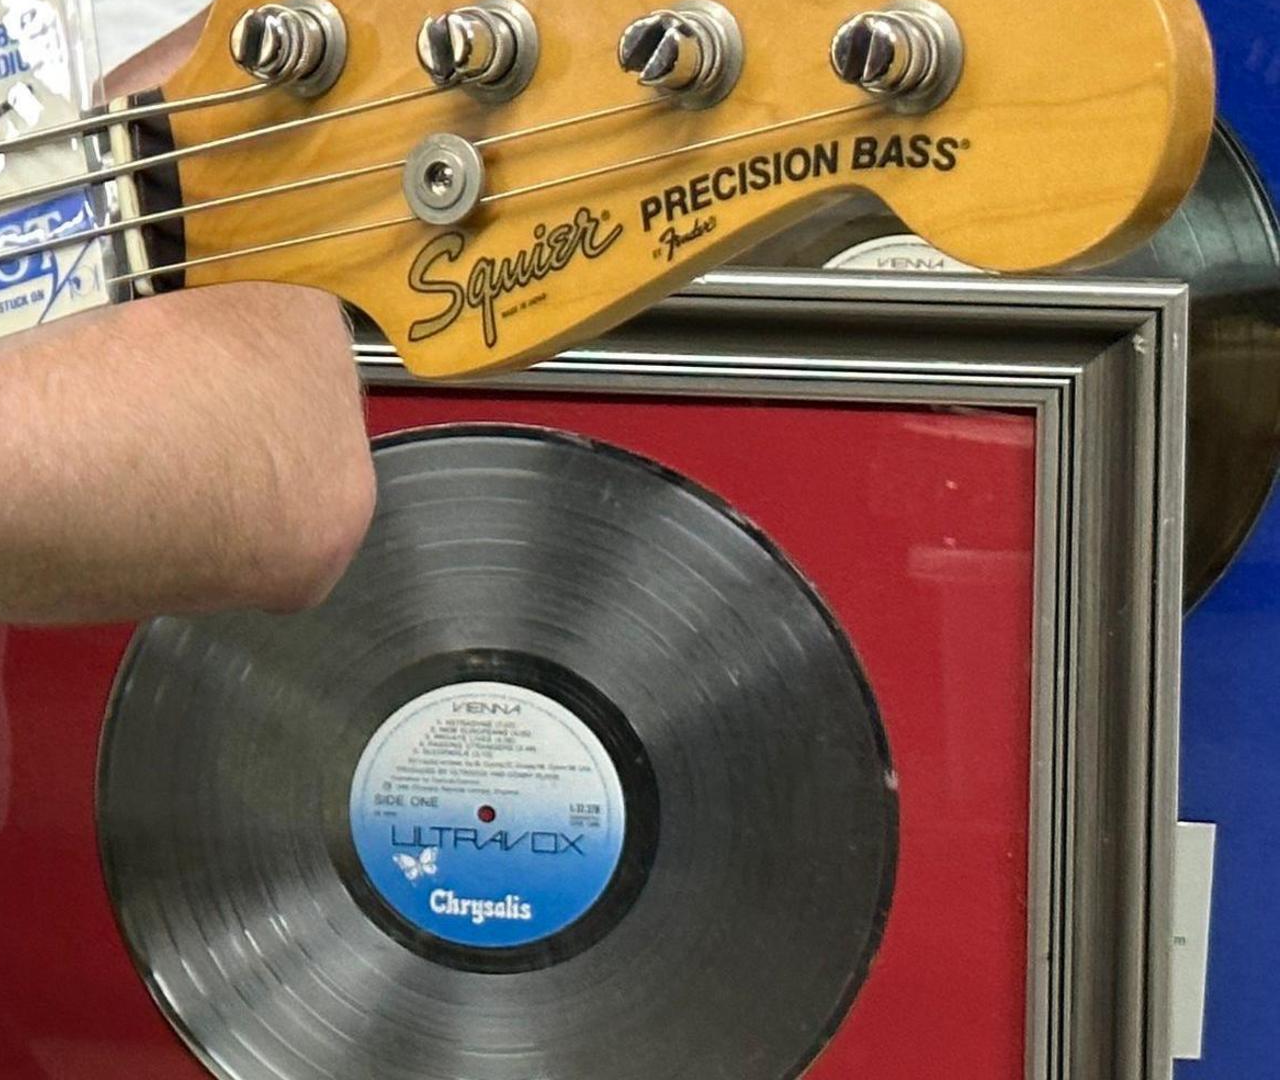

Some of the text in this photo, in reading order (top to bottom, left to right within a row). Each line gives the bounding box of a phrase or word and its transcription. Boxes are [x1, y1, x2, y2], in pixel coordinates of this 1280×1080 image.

[641, 139, 839, 232] PRECISION
[877, 257, 944, 269] VIENNA
[31, 289, 45, 303] ON
[452, 702, 522, 715] VIENNA
[374, 794, 404, 807] SIDE
[410, 795, 439, 808] ONE
[392, 825, 585, 856] ULTRAVOX
[429, 888, 531, 924] Chrysalis
